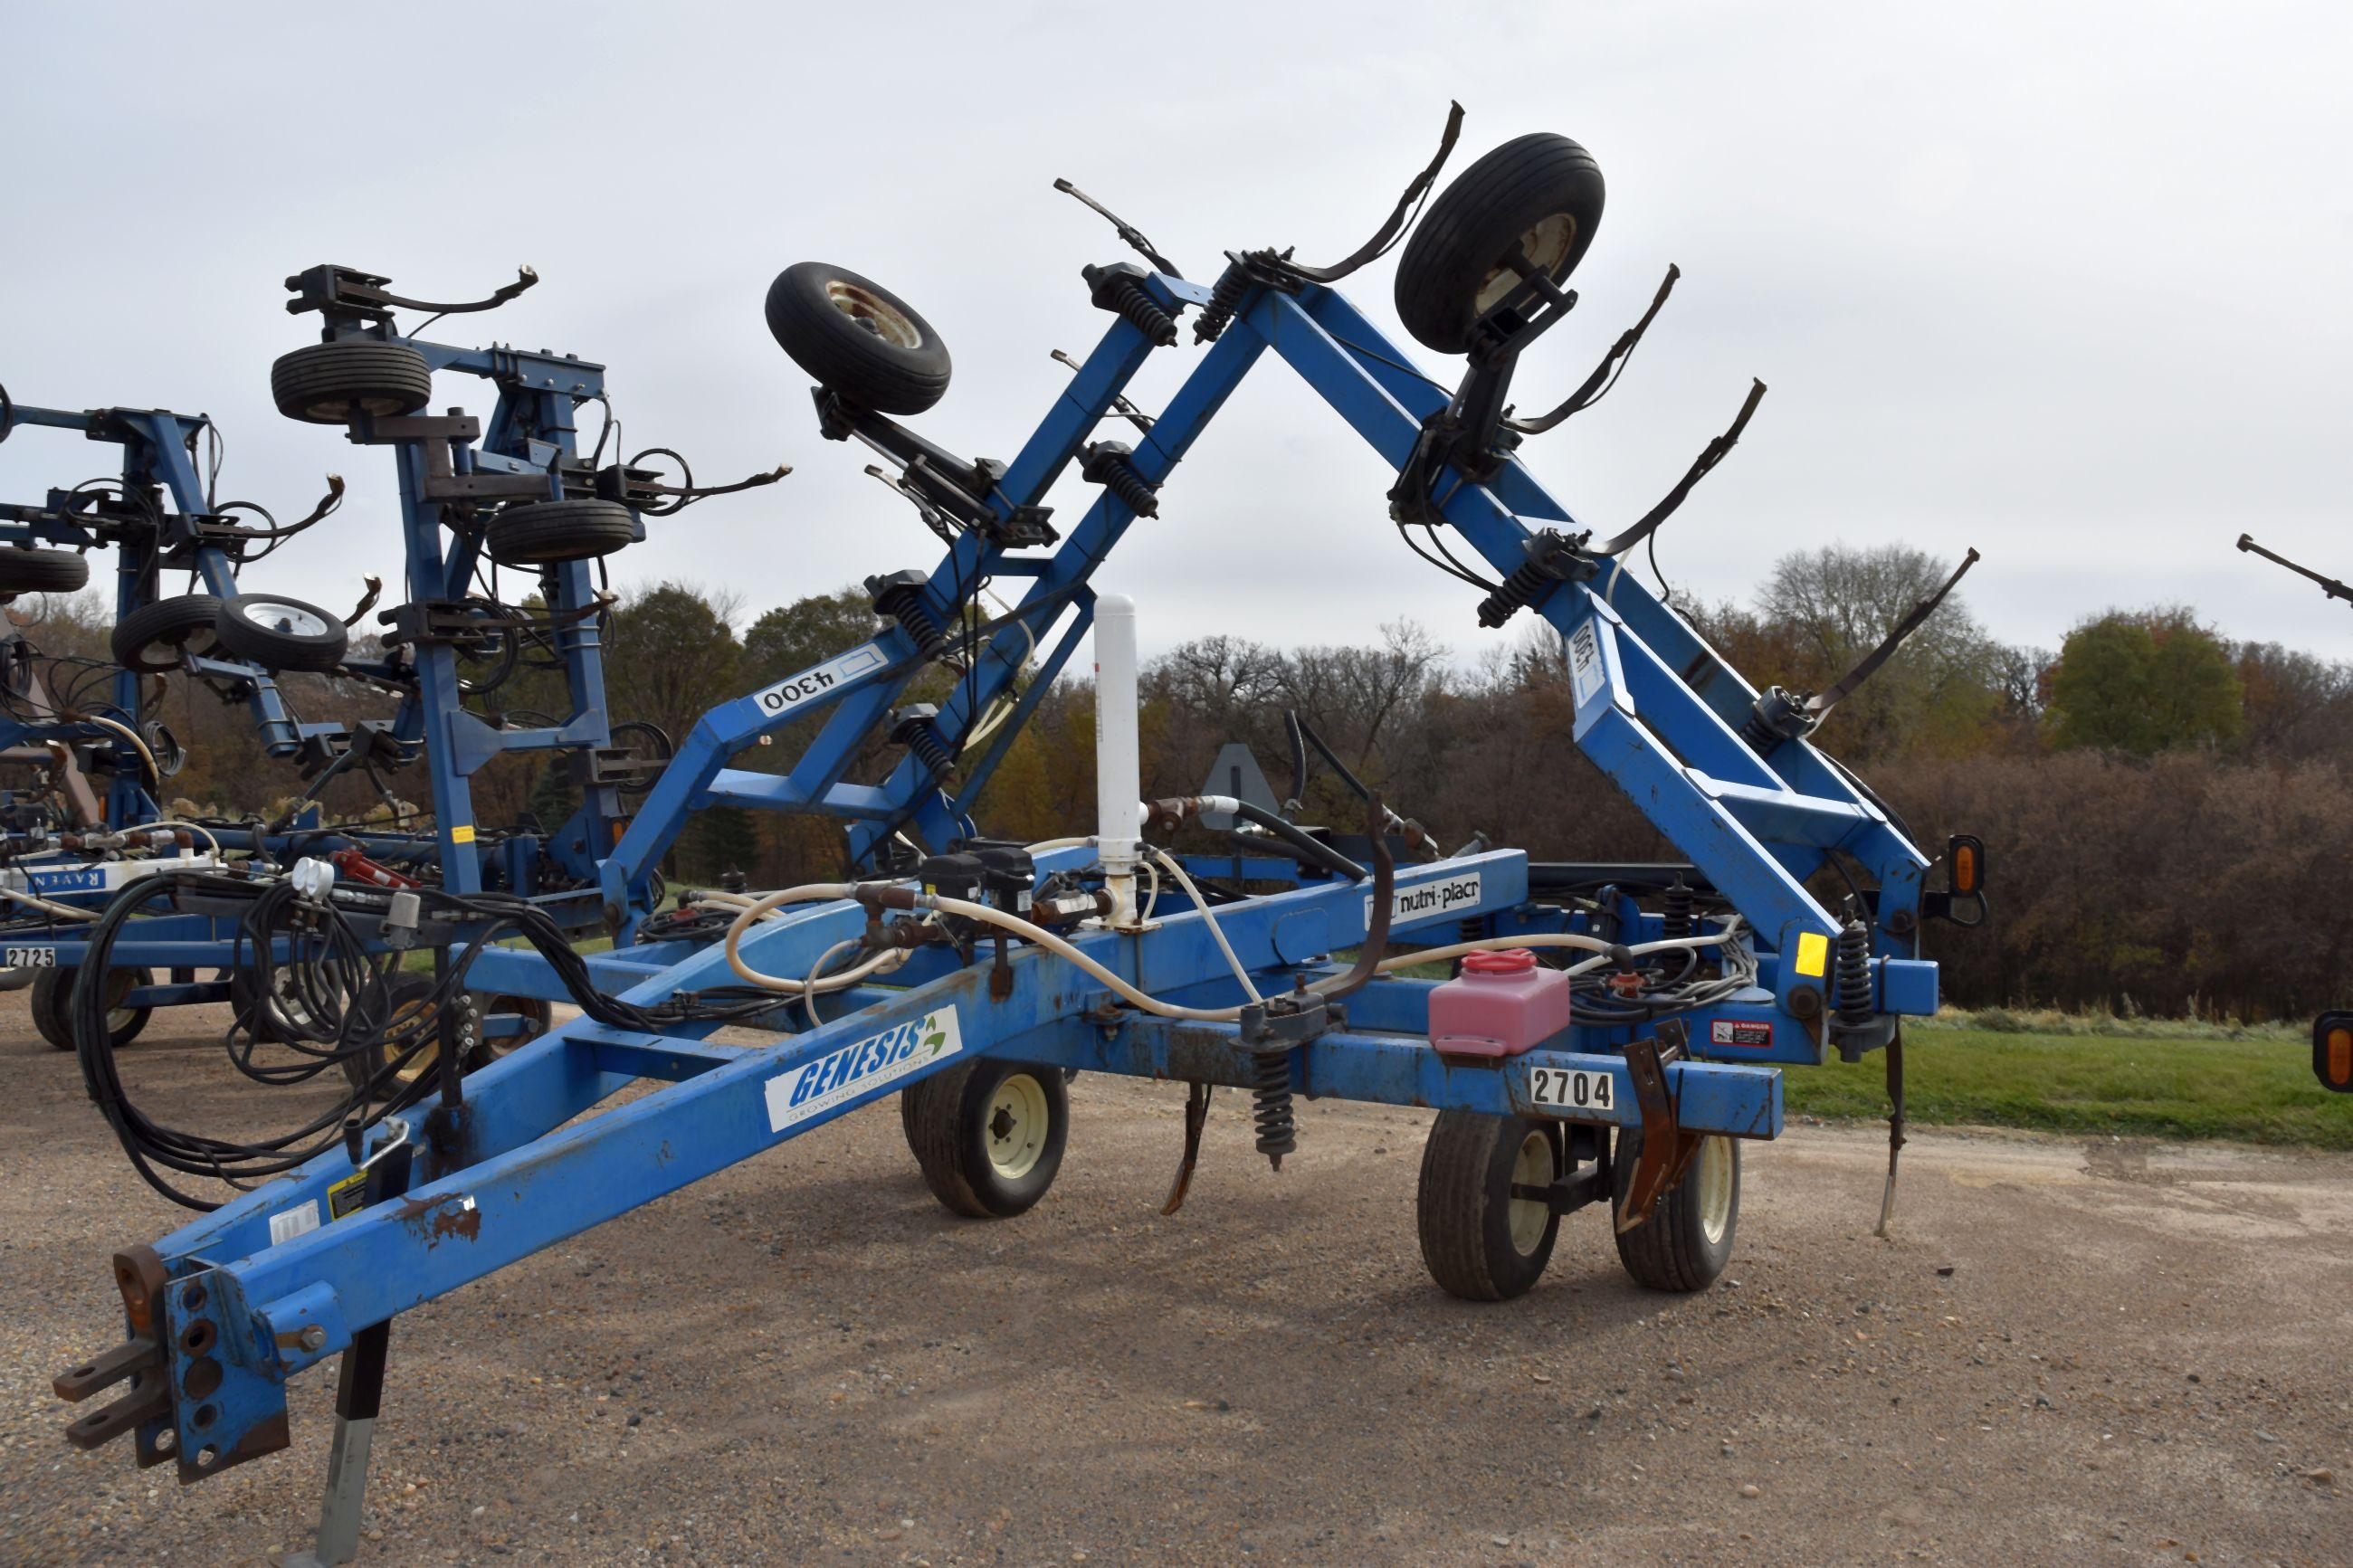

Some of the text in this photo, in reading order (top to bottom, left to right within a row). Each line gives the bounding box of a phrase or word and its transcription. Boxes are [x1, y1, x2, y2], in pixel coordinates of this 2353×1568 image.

[764, 671, 834, 710] 4300
[34, 873, 99, 887] RAVEN
[9, 949, 54, 967] 2725
[789, 1018, 926, 1107] GENESIS
[788, 1056, 929, 1123] GROWING SOLUTIONS
[1534, 1069, 1611, 1107] 2704
